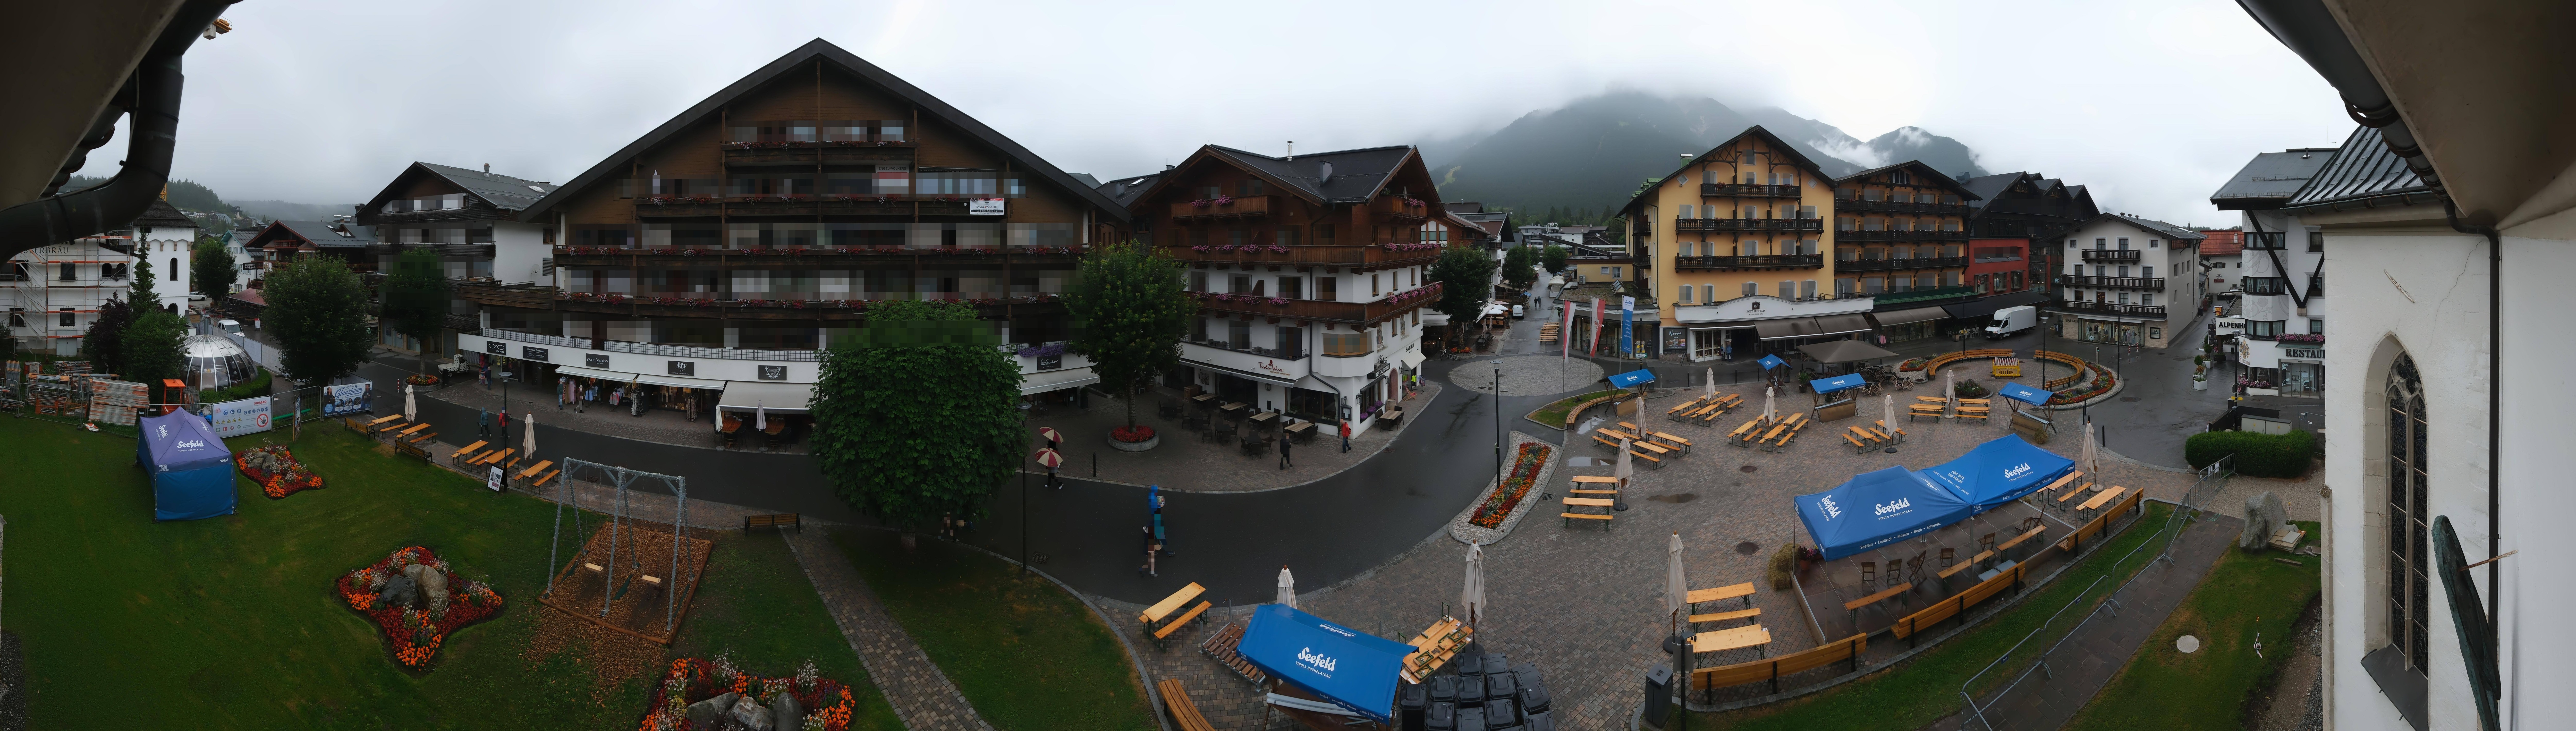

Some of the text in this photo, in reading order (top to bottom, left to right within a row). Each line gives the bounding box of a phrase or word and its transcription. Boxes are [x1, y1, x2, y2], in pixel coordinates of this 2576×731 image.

[1406, 343, 1414, 352] SAILER
[2239, 356, 2250, 365] Kaltschmid
[676, 362, 687, 372] My
[1375, 365, 1389, 377] RESTAURANT
[335, 387, 363, 400] Glanzbuam
[159, 425, 168, 438] Seefeld
[177, 440, 204, 448] Seefeld
[2004, 462, 2030, 478] Seefeld
[2017, 471, 2033, 479] HOCHPLATEAU
[1821, 495, 1841, 518] Seefeld
[1875, 497, 1910, 515] Seefeld
[1821, 507, 1830, 522] HOCHPLATEAU
[1890, 509, 1912, 518] HOCHPLATEAU
[1319, 624, 1355, 637] Seefeld
[1298, 647, 1336, 671] Seefeld
[1307, 666, 1331, 678] HOCHPLATEAU
